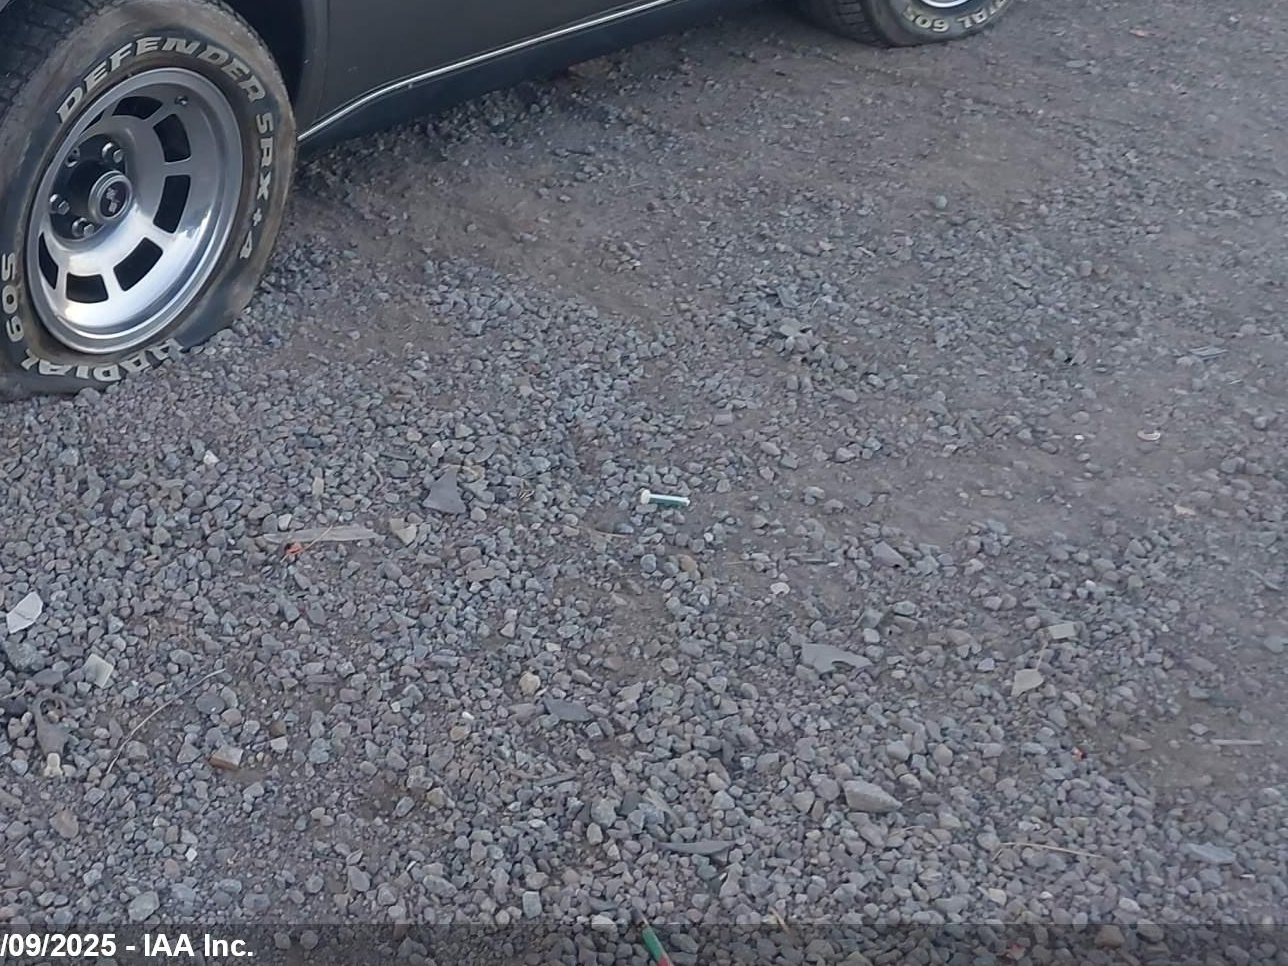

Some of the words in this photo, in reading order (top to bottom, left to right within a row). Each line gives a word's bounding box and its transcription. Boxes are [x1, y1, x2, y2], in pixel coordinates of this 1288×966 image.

[56, 35, 267, 124] DEFENDER
[1, 252, 25, 343] 60S
[21, 337, 184, 382] RADIAL
